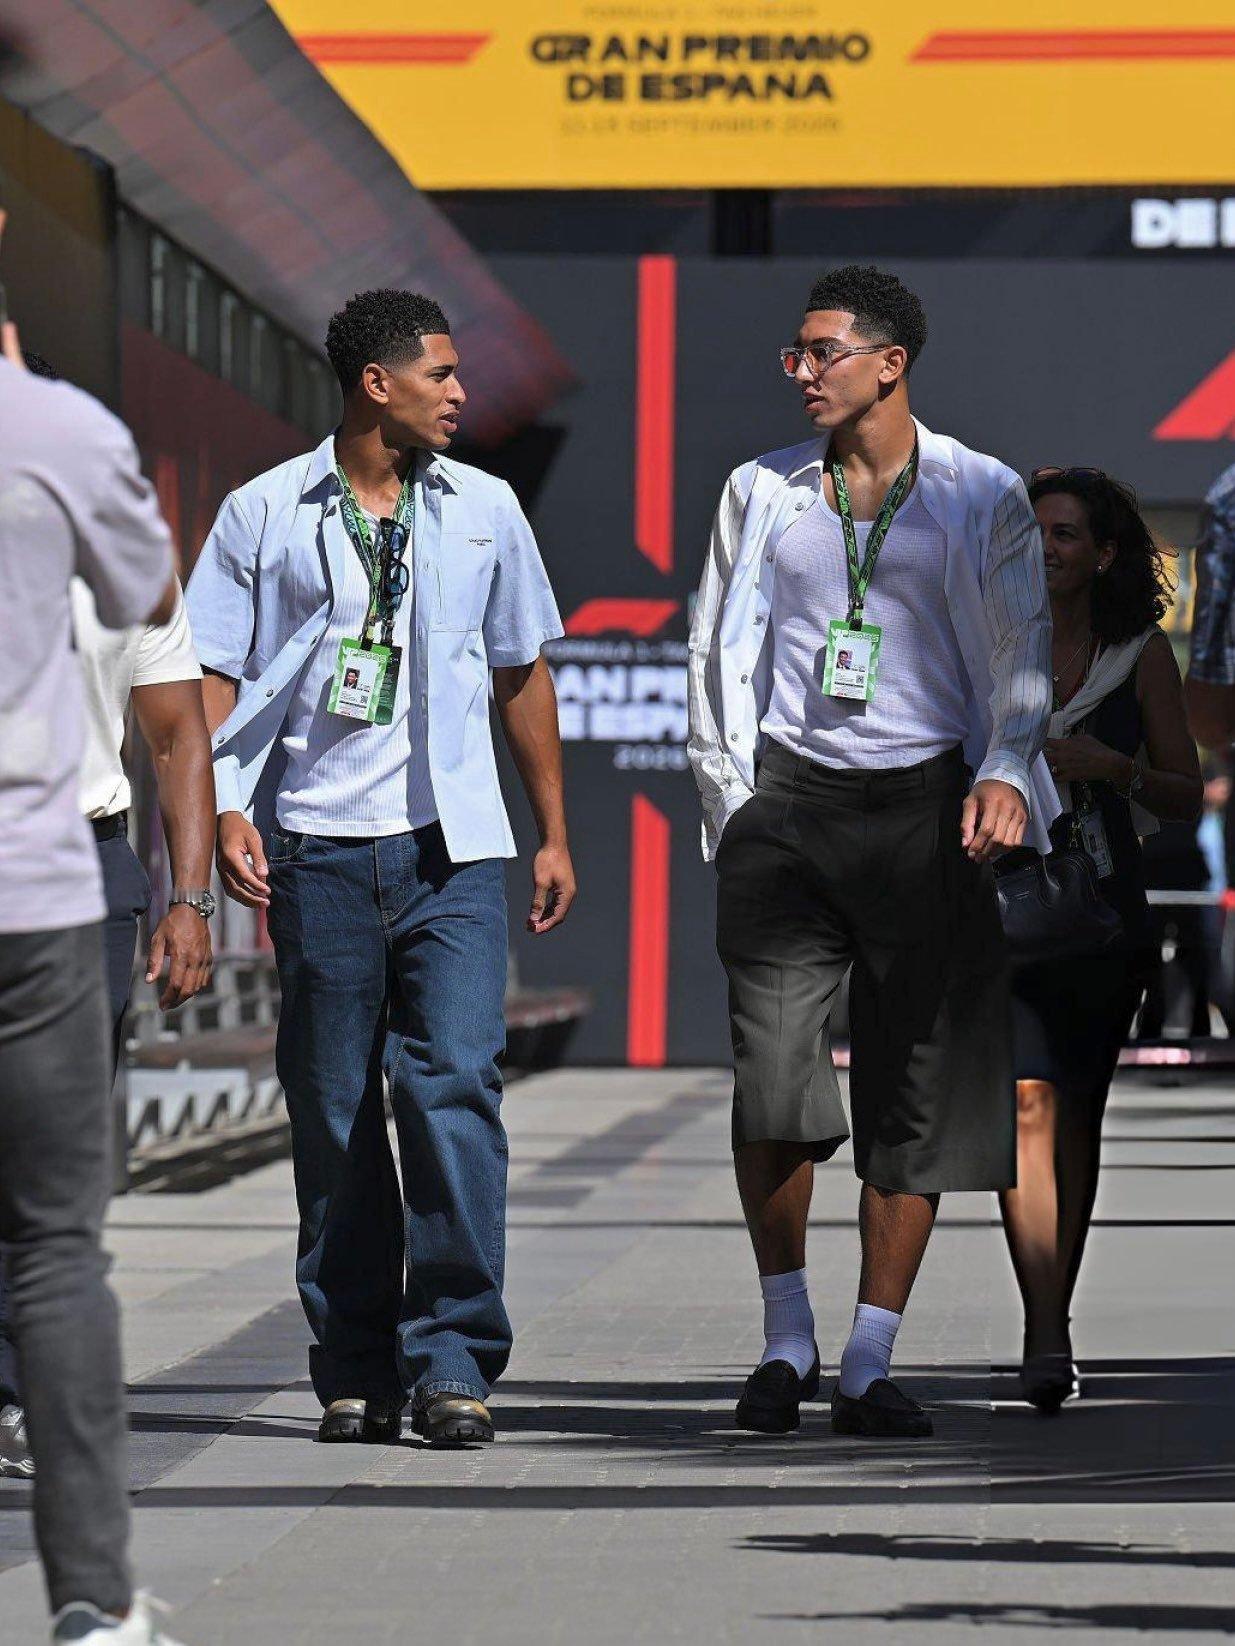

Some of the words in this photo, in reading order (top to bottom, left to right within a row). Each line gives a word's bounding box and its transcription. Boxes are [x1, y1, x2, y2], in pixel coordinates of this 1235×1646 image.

[532, 34, 668, 63] GRAN
[682, 34, 871, 63] PREMIO
[567, 73, 624, 101] DE
